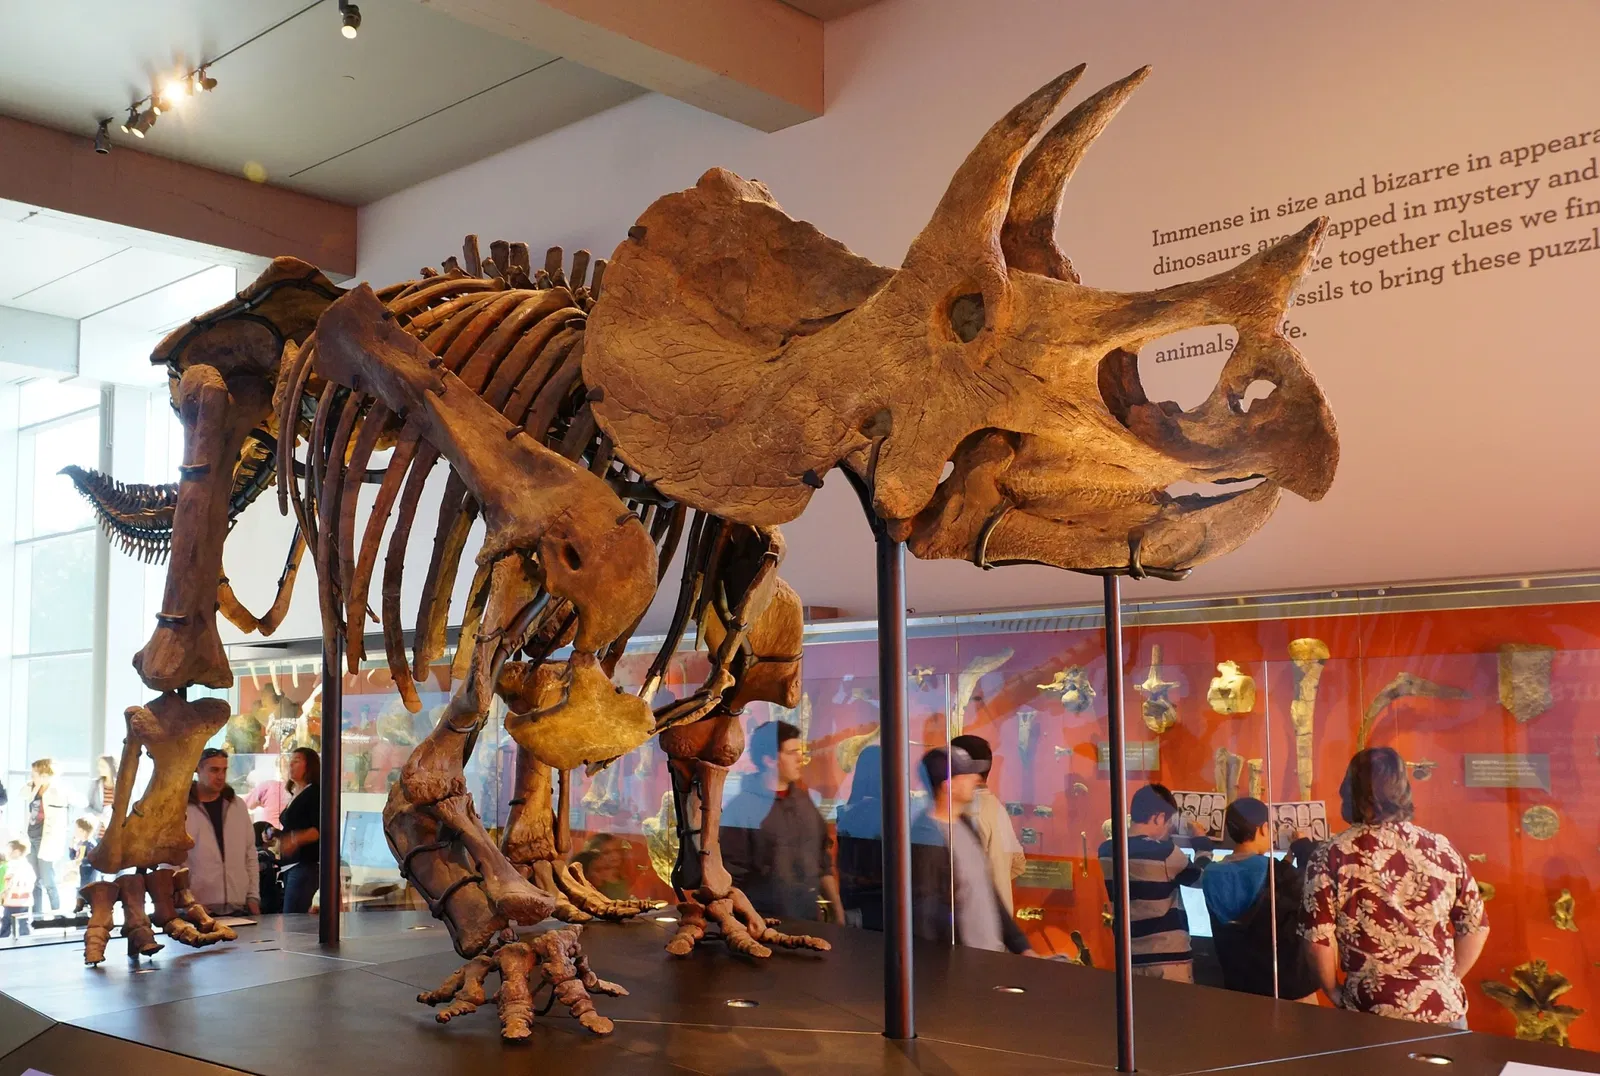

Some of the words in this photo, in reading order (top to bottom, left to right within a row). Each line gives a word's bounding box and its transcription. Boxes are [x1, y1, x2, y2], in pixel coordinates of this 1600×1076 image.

[1152, 214, 1245, 247] Immense
[1250, 206, 1271, 224] in
[1277, 196, 1318, 218] size
[1324, 178, 1367, 207] and
[1372, 162, 1460, 195] bizarre
[1467, 153, 1493, 173] in
[1152, 243, 1251, 276] dinosaurs
[1327, 202, 1397, 240] apped
[1403, 201, 1428, 221] in
[1433, 177, 1541, 214] mystery
[1547, 156, 1600, 189] and
[1338, 232, 1441, 267] together
[1447, 219, 1513, 244] clues
[1519, 209, 1558, 229] we
[1564, 196, 1600, 220] fin
[1295, 280, 1344, 307] ssils
[1349, 279, 1373, 296] to
[1378, 265, 1445, 291] bring
[1451, 251, 1521, 276] these
[1528, 227, 1600, 268] puzzl
[1155, 332, 1235, 364] animals
[1282, 319, 1307, 339] fe.
